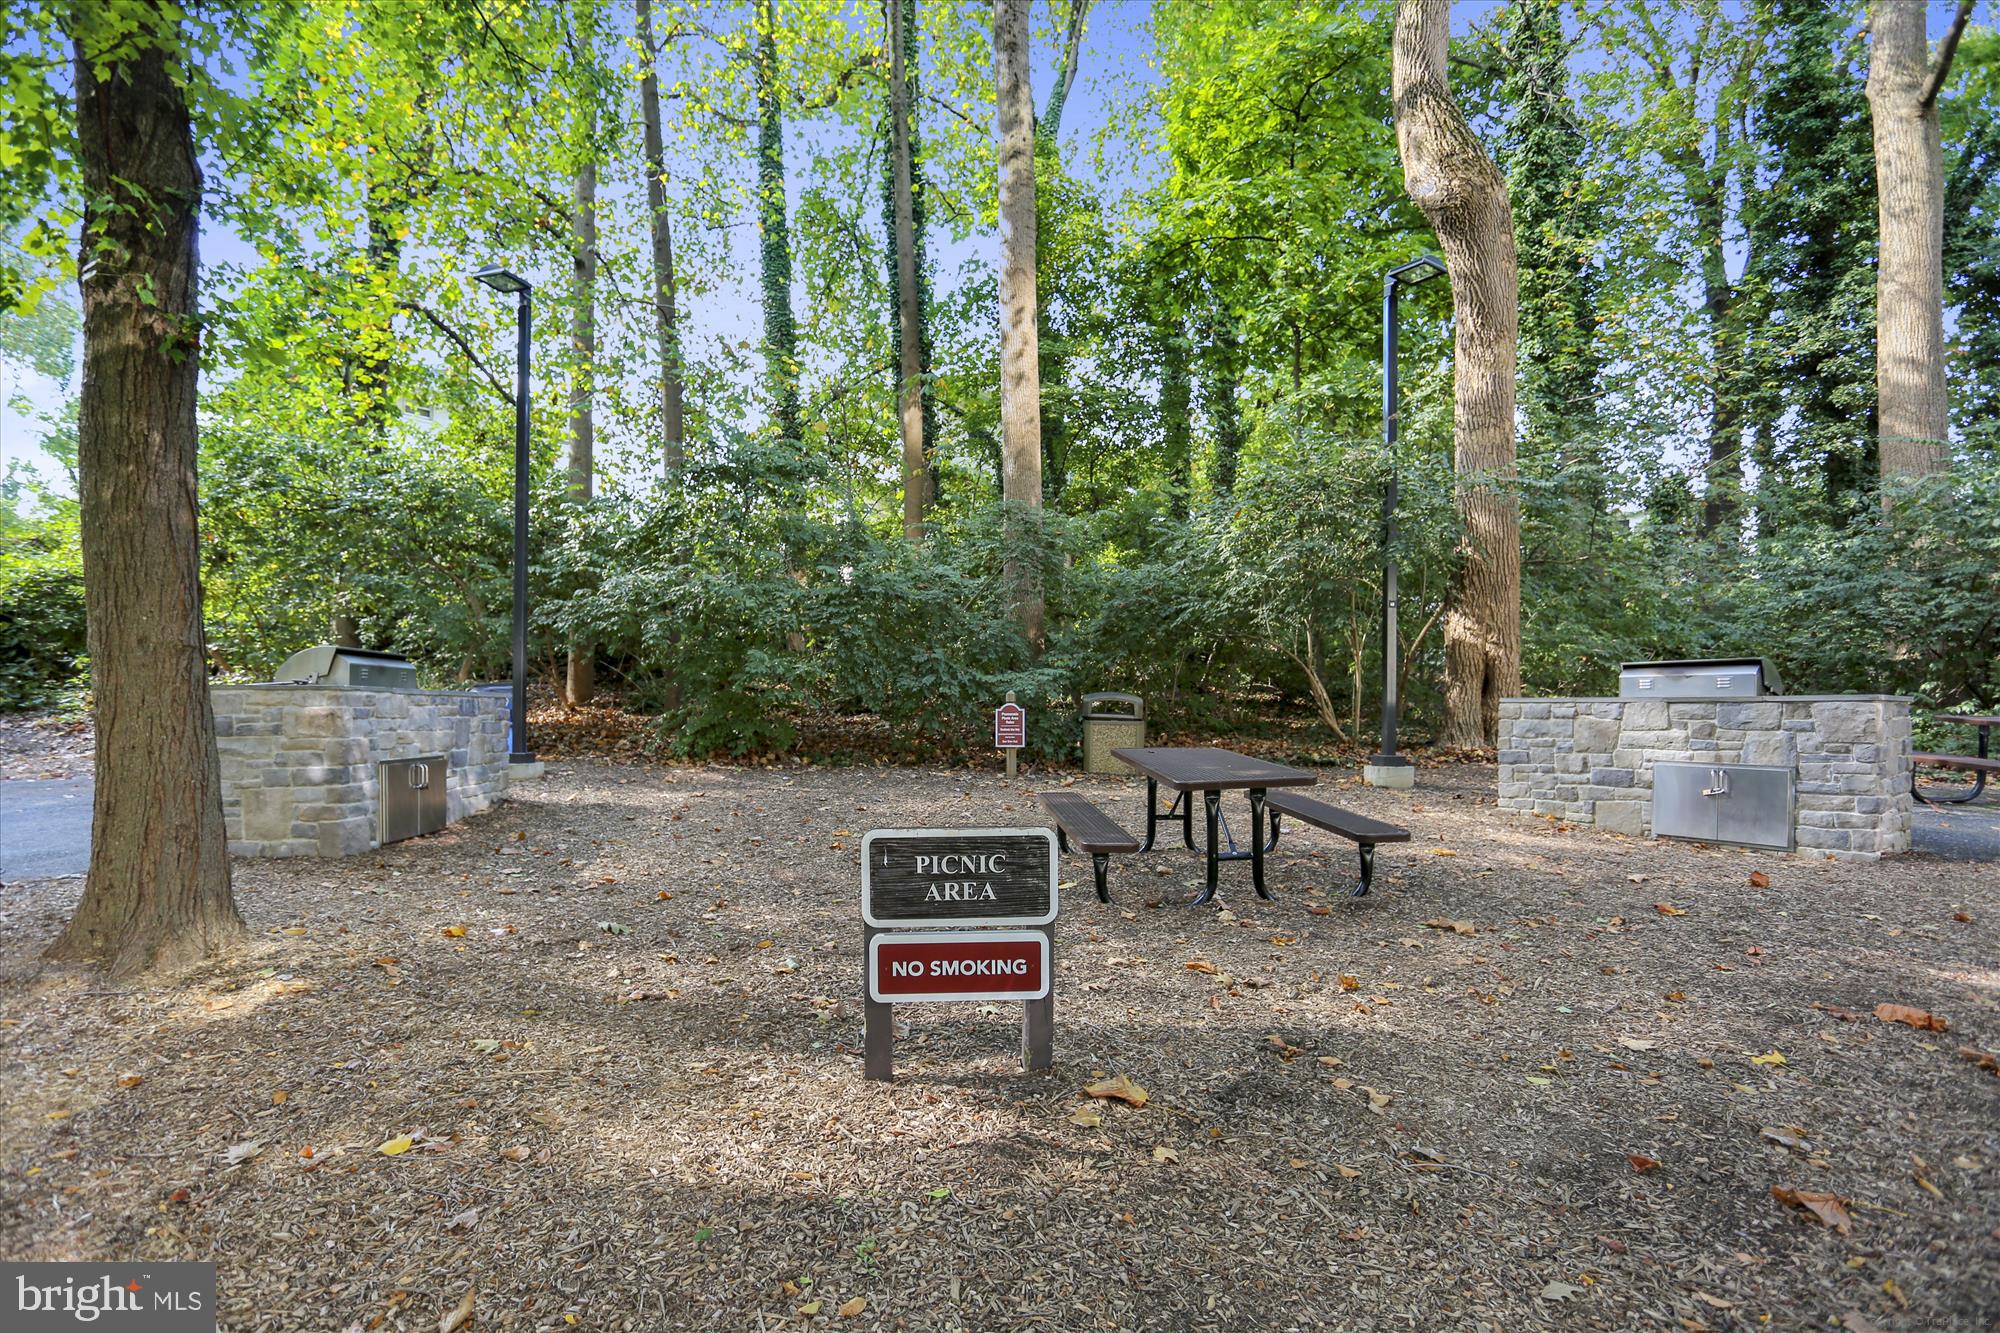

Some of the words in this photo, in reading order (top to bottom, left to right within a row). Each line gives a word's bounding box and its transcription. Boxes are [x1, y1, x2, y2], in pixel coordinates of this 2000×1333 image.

[915, 855, 1006, 874] PICNIC
[924, 882, 997, 901] AREA
[892, 961, 924, 977] NO
[930, 959, 1028, 977] SMOKING
